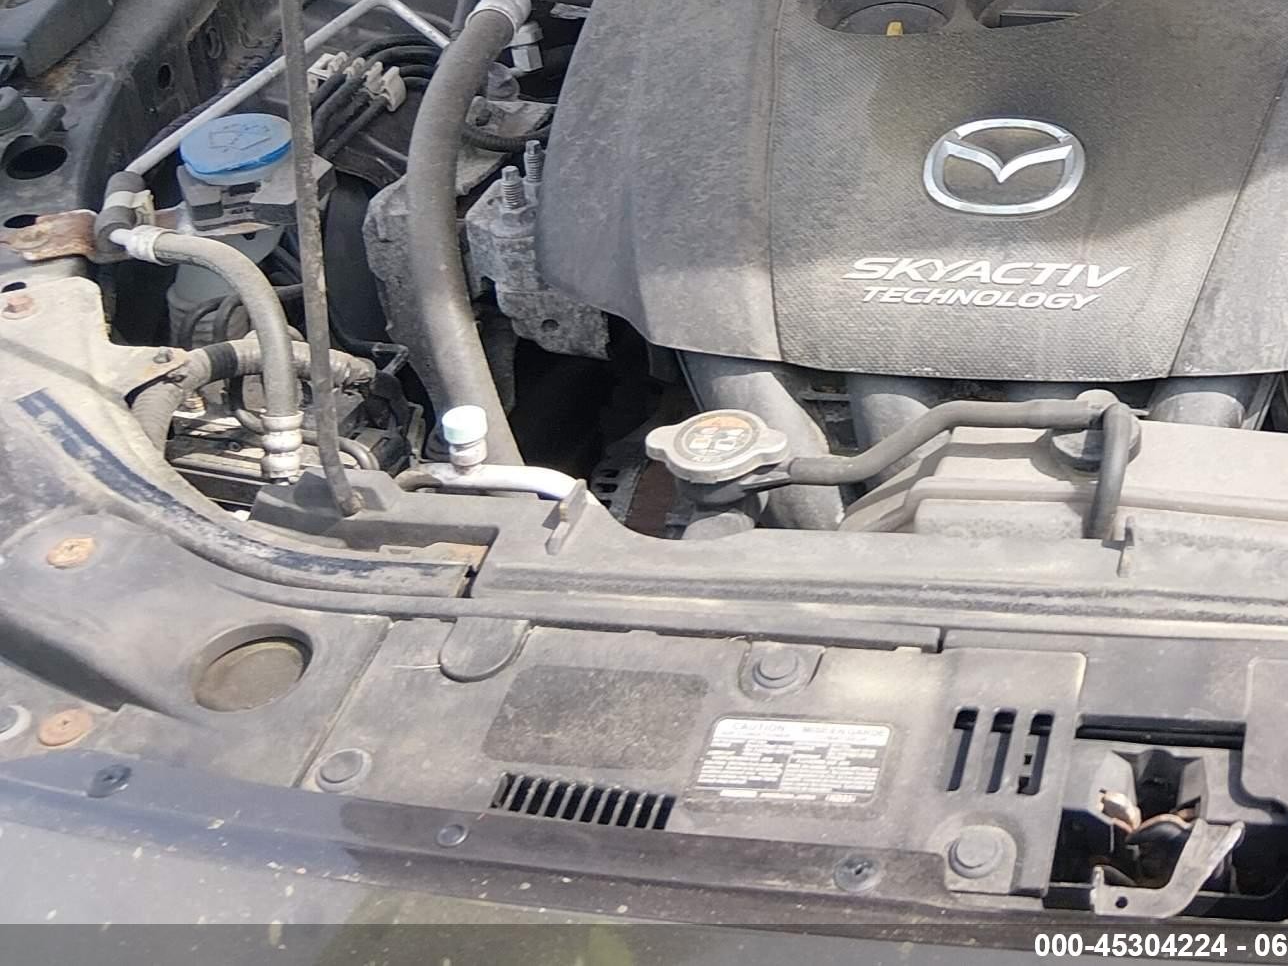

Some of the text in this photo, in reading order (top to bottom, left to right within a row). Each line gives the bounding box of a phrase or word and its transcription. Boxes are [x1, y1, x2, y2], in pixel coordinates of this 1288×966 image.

[842, 257, 1132, 288] SKYACTIV
[862, 286, 1101, 311] TECHNOLOGY
[732, 722, 785, 732] CAUTION
